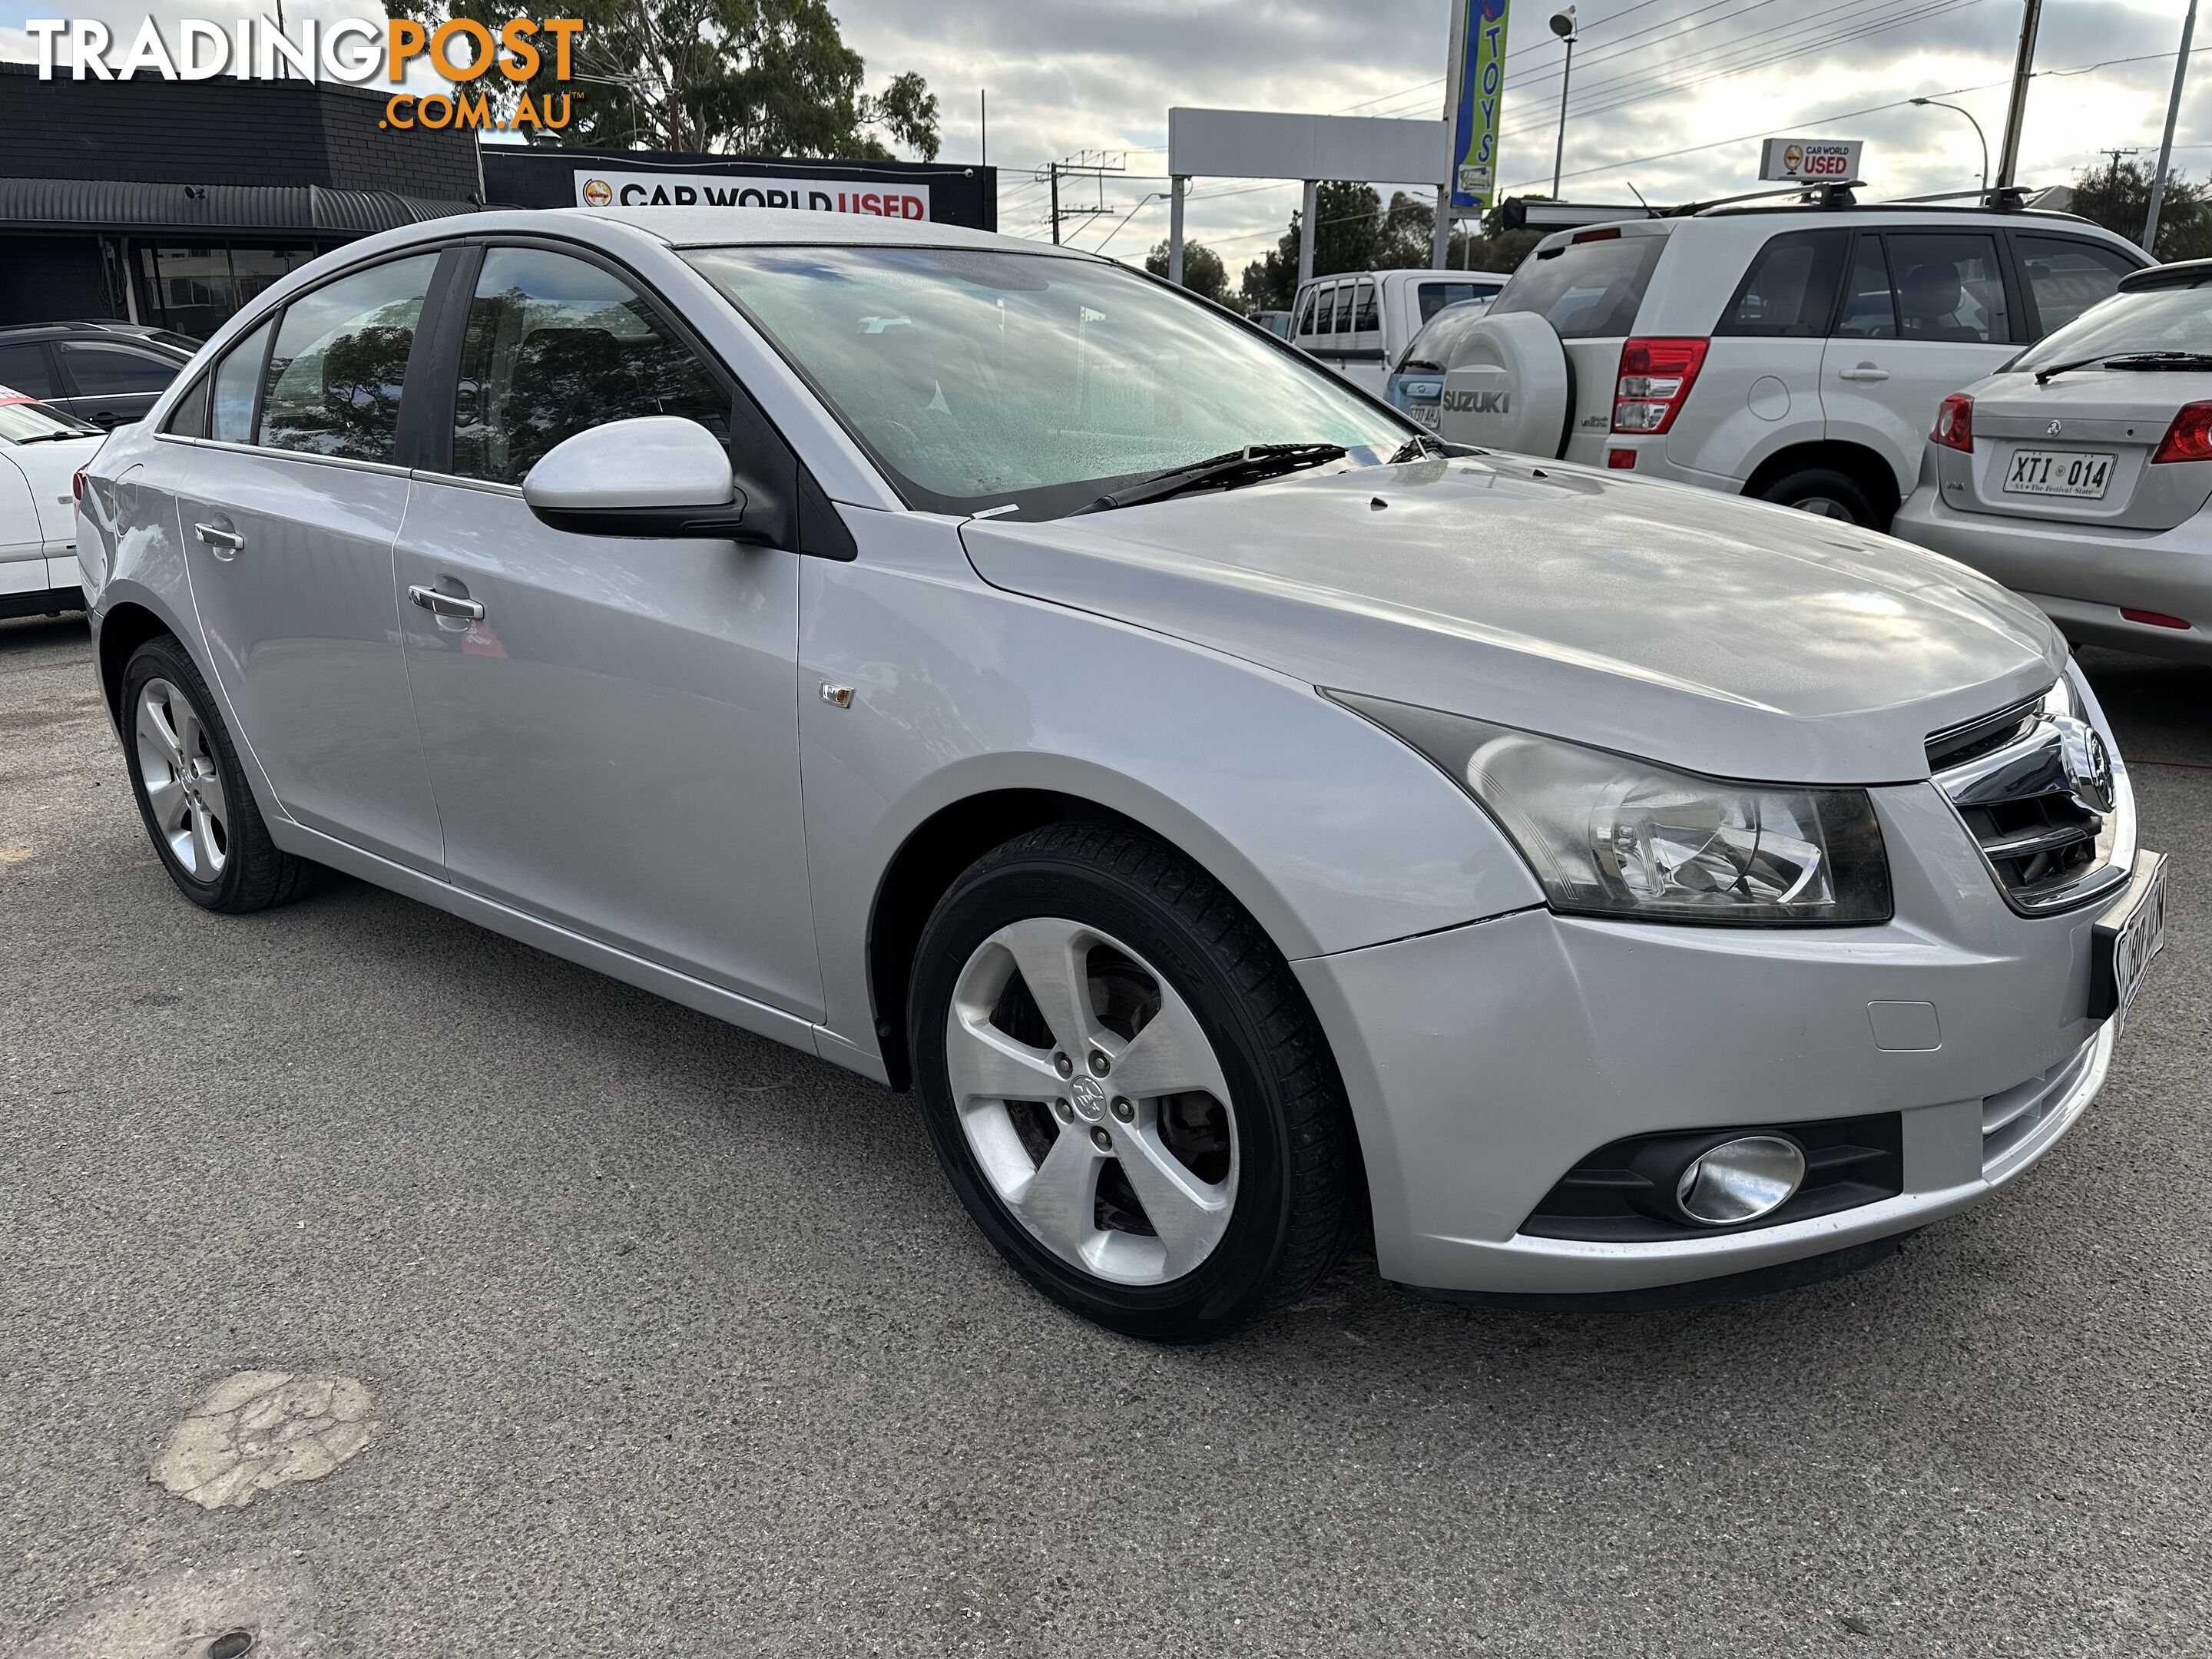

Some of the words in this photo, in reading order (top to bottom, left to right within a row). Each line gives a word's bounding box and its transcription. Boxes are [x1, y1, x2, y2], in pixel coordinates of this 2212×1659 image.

[1477, 26, 1501, 163] TOYS
[1806, 146, 1823, 154] CAR
[1823, 147, 1849, 155] WORLD
[1804, 156, 1847, 174] USED
[620, 184, 697, 206] CAR
[838, 193, 923, 221] USED
[1442, 390, 1511, 413] SUZUKI
[2012, 457, 2052, 483] XTI
[2068, 460, 2107, 488] 014
[2045, 485, 2072, 494] Festival
